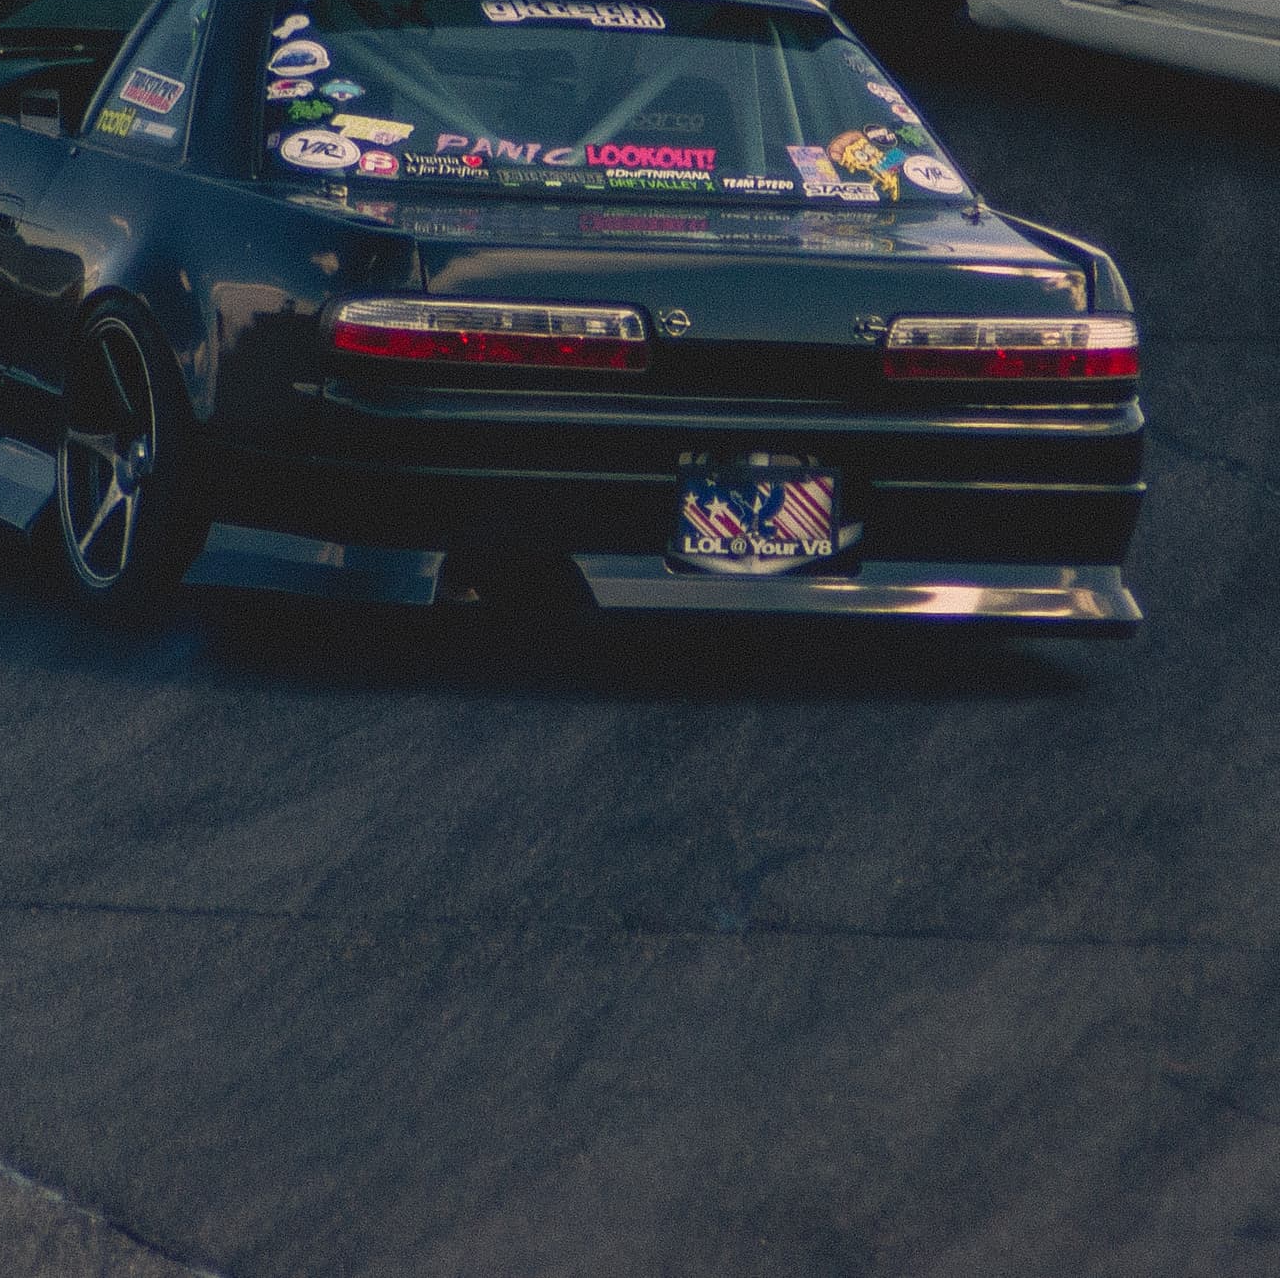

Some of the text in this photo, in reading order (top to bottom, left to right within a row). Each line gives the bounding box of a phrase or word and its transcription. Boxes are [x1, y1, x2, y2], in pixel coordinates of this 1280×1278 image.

[436, 133, 575, 166] PANIC
[586, 143, 717, 170] LOOKOUT!
[404, 152, 460, 167] Virginia
[609, 179, 698, 190] DRIFTVALLEY
[723, 178, 755, 189] TEAM
[684, 536, 833, 556] LOL @ Your V8
